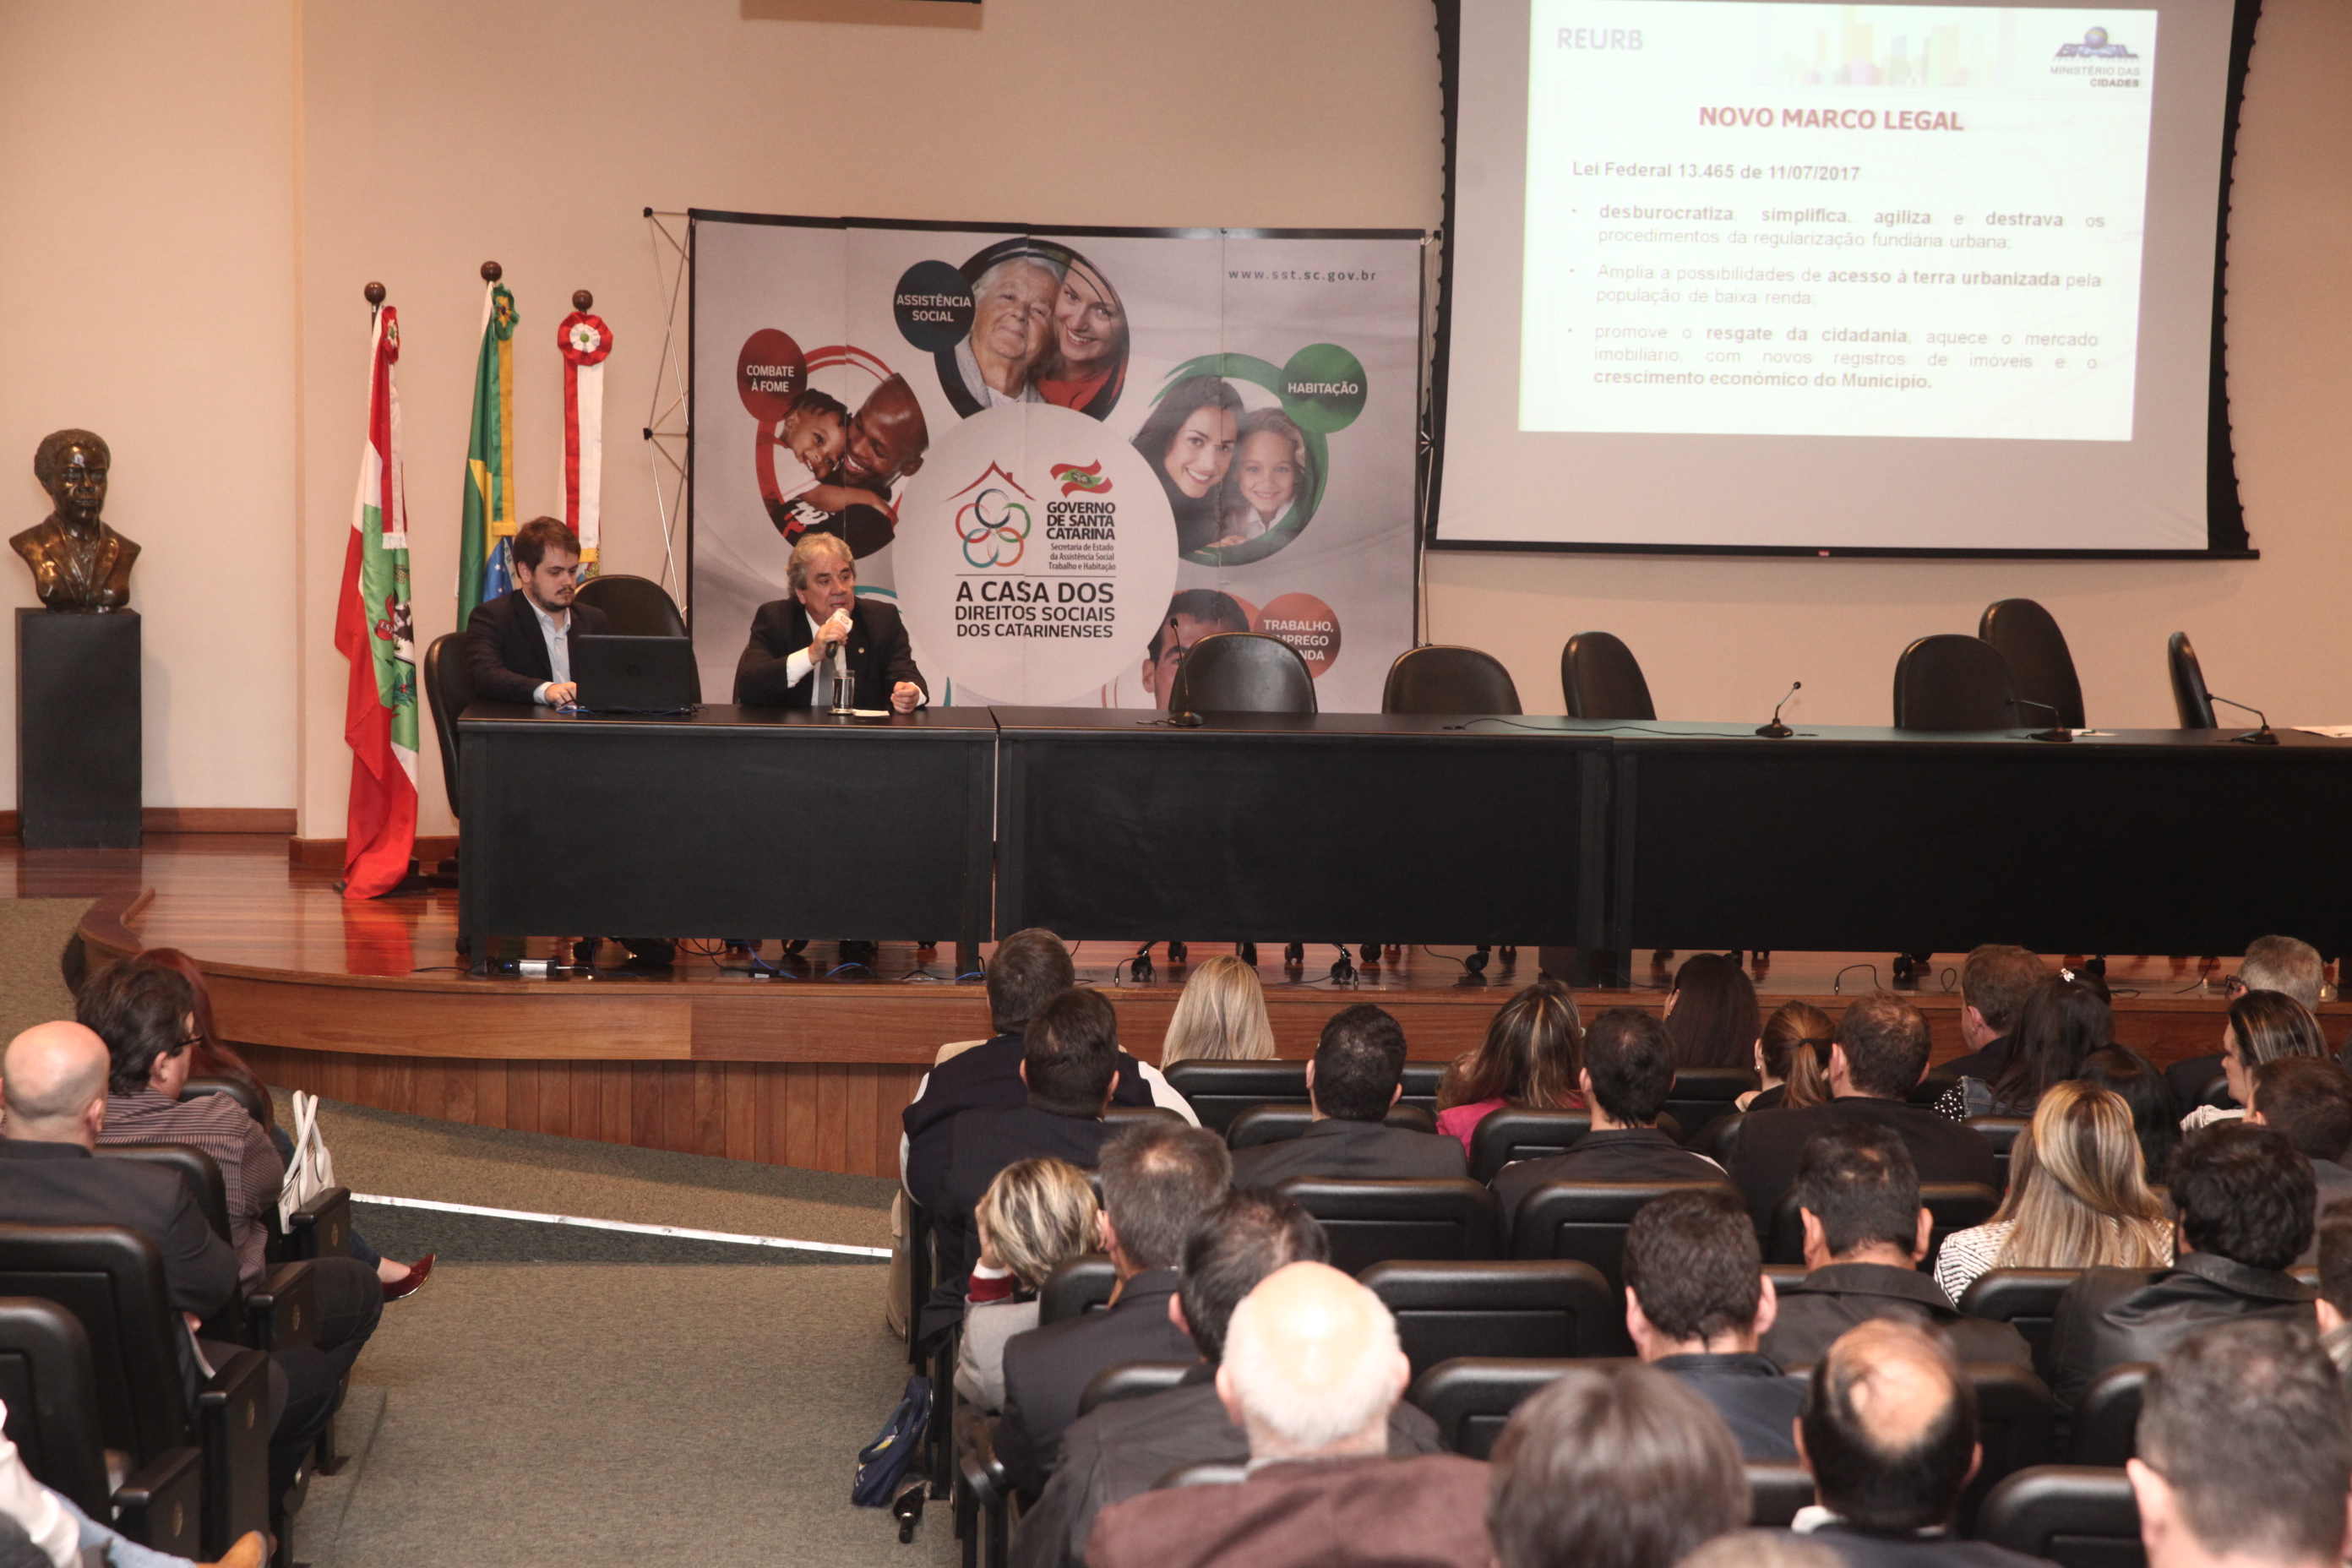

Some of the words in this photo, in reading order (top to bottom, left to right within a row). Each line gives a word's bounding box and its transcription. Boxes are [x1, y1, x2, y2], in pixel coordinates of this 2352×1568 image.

[1556, 27, 1643, 51] REURB
[2049, 65, 2115, 76] MINISTÉRIO
[2117, 67, 2140, 77] DAS
[2089, 78, 2140, 89] CIDADES
[1699, 106, 1775, 128] NOVO
[1781, 107, 1876, 130] MARCO
[1883, 110, 1965, 132] LEGAL
[1572, 161, 1599, 177] Lei
[1604, 161, 1672, 177] Federal
[1678, 163, 1734, 179] 13.465
[1740, 164, 1762, 180] de
[1768, 165, 1860, 182] 11/07/2017
[1873, 209, 1932, 228] agiliza
[1952, 214, 1964, 226] e
[1984, 210, 2064, 228] destrava
[2084, 215, 2105, 228] os
[1598, 227, 1720, 246] procedimentos
[1727, 229, 1747, 244] da
[1753, 230, 1865, 250] regularização
[1871, 231, 1943, 248] fundiária
[1228, 270, 1376, 282] www.sst.sc.gov.br
[1596, 264, 1654, 283] Amplia
[1659, 268, 1670, 280] a
[1676, 265, 1795, 284] possibilidades
[1800, 267, 1822, 283] de
[1827, 270, 1892, 285] acesso
[1912, 270, 1956, 285] terra
[1961, 270, 2061, 287] urbanizada
[2065, 272, 2102, 291] pela
[896, 292, 972, 308] ASSISTÊNCIA
[1596, 286, 1681, 307] população
[1688, 288, 1709, 303] de
[1714, 288, 1757, 304] baixa
[912, 310, 954, 322] SOCIAL
[1594, 327, 1668, 342] promove
[1681, 328, 1692, 340] o
[1706, 326, 1773, 345] resgate
[1785, 326, 1808, 342] da
[1925, 332, 1988, 348] aquece
[2001, 334, 2012, 346] o
[2024, 331, 2099, 347] mercado
[1705, 351, 1741, 363] com
[1762, 352, 1812, 365] novos
[1833, 351, 1906, 369] registros
[1927, 351, 1948, 367] de
[1969, 352, 2034, 368] imóveis
[2054, 357, 2066, 369] e
[2086, 357, 2098, 370] o
[746, 365, 795, 377] COMBATE
[1593, 369, 1705, 385] crescimento
[1709, 370, 1809, 387] econômico
[1813, 372, 1837, 387] do
[751, 378, 759, 392] À
[760, 381, 789, 393] FOME
[1288, 381, 1358, 396] HABITAÇÃO
[1047, 502, 1116, 514] GOVERNO
[1047, 514, 1065, 526] DE
[1069, 514, 1115, 527] SANTA
[1046, 528, 1115, 540] CATARINA
[1059, 553, 1094, 561] Assistência
[1083, 563, 1116, 572] Habitação
[956, 581, 973, 602] A
[981, 581, 1049, 603] CASA
[1058, 583, 1114, 603] DOS
[956, 606, 1036, 621] DIREITOS
[1042, 607, 1115, 621] SOCIAIS
[957, 623, 989, 636] DOS
[994, 623, 1113, 638] CATARINENSES
[1264, 620, 1334, 632] TRABALHO,
[1298, 650, 1325, 660] NDA
